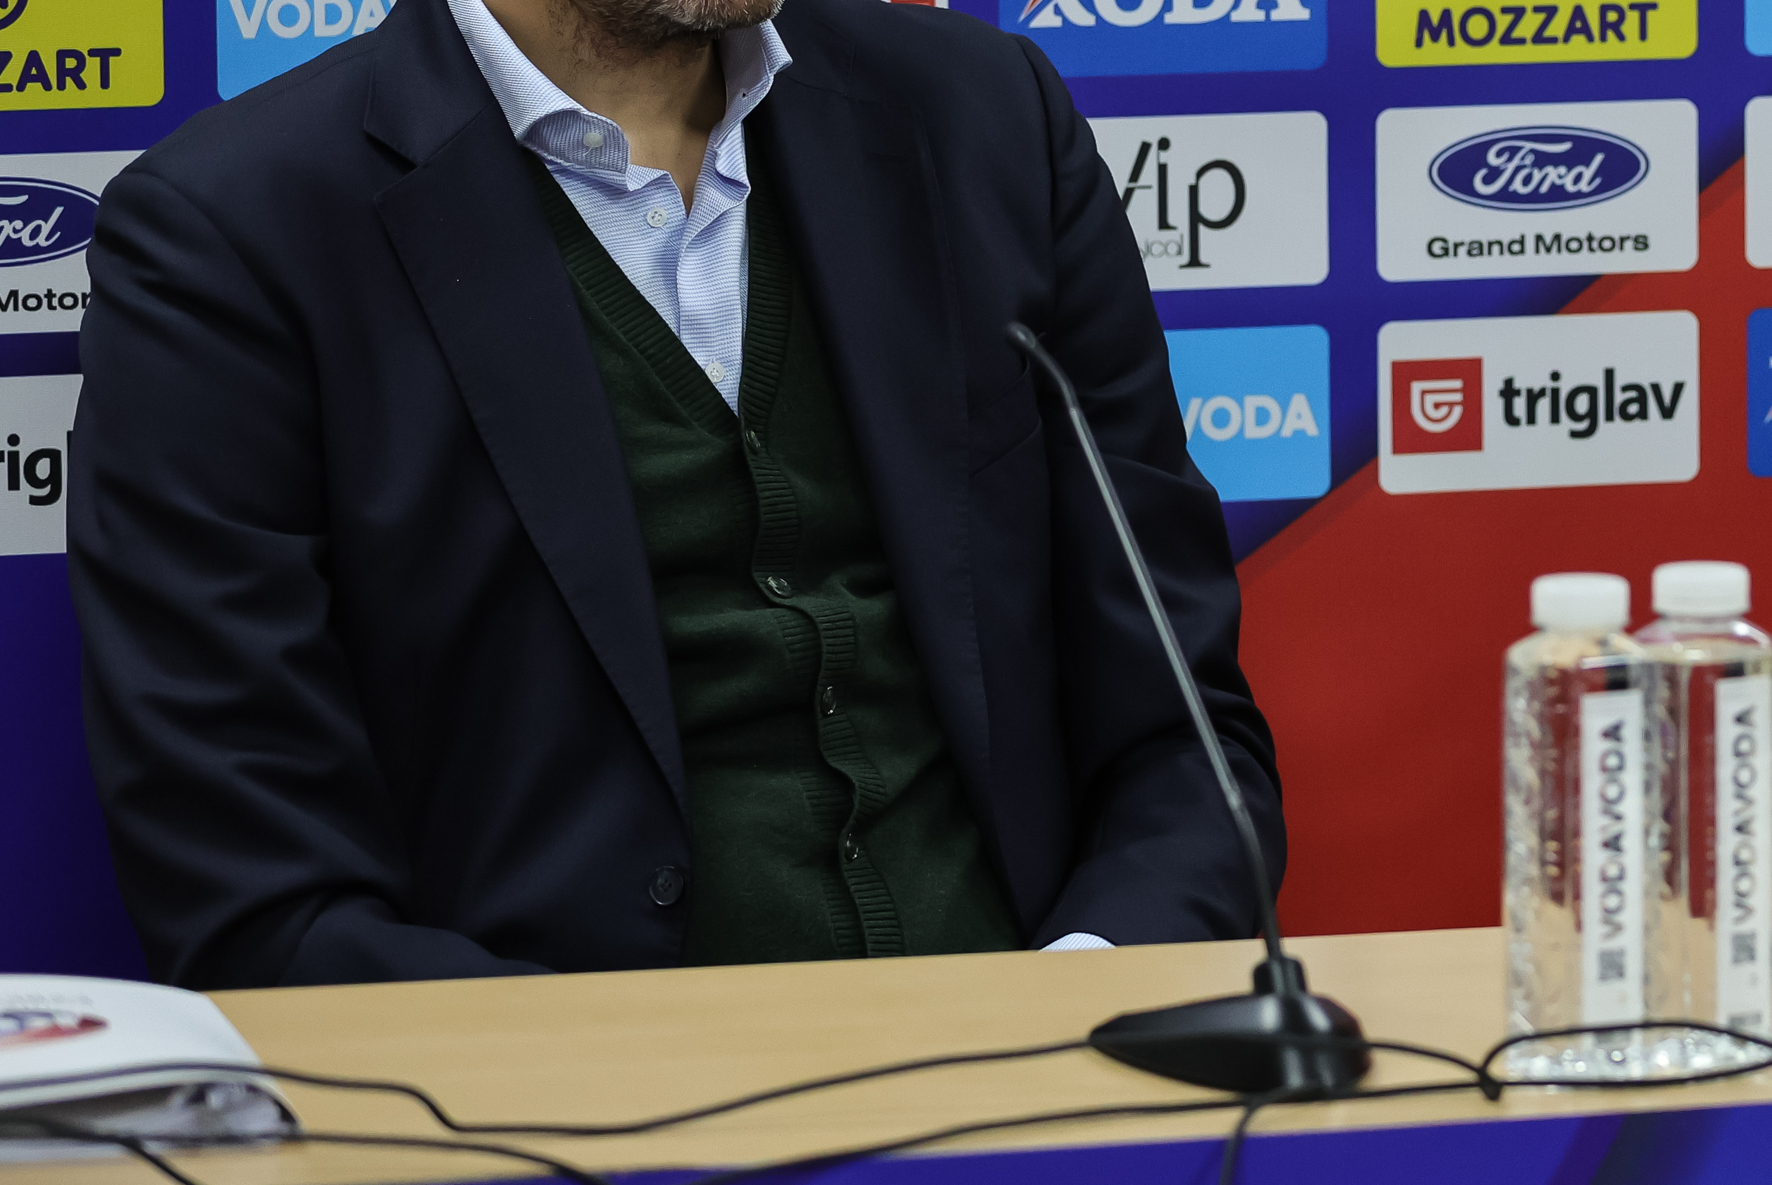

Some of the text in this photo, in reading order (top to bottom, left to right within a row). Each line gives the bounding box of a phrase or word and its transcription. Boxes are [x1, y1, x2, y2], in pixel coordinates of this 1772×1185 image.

[1415, 2, 1658, 48] MOZZART
[1474, 141, 1604, 194] Ford
[1427, 233, 1649, 258] Grand Motors
[1499, 368, 1684, 439] triglav
[1599, 719, 1627, 943] VODAVODA
[1731, 706, 1757, 924] VODAVODA
